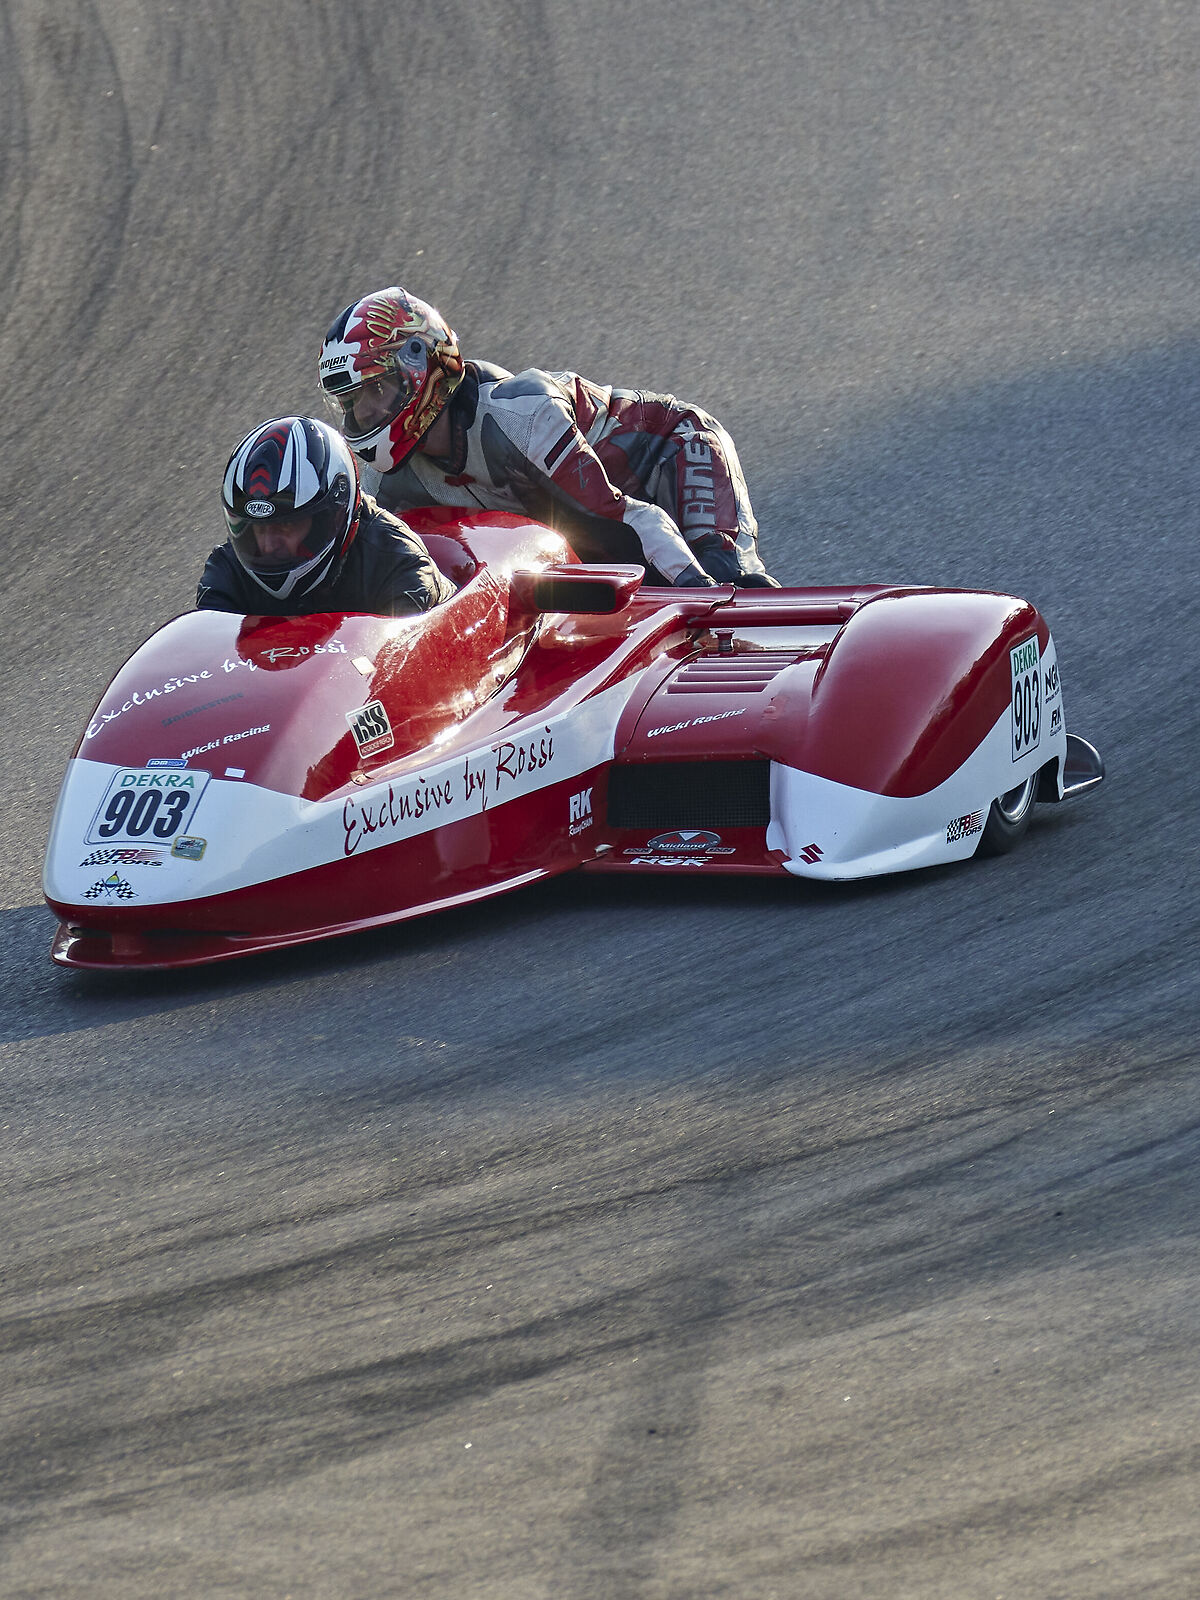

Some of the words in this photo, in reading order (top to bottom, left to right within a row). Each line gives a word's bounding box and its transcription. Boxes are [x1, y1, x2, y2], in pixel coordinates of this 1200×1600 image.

[320, 354, 349, 370] NOLAN
[247, 503, 272, 513] PREMIER
[1013, 641, 1038, 677] DEKRA
[85, 670, 213, 740] Exclusive
[220, 658, 258, 672] by
[261, 639, 348, 663] Rossi
[647, 720, 692, 738] Wicki
[692, 708, 747, 726] Racing
[1014, 669, 1039, 752] 903
[181, 738, 220, 760] Wicki
[223, 723, 271, 745] Racing
[120, 774, 195, 788] DEKRA
[342, 776, 454, 856] Exclusive
[463, 756, 488, 812] by
[490, 726, 555, 791] Rossi
[98, 789, 191, 838] 903
[569, 787, 593, 823] RK
[946, 824, 983, 844] MOTORS
[79, 859, 164, 868] MOTORS
[629, 857, 709, 867] NGK
